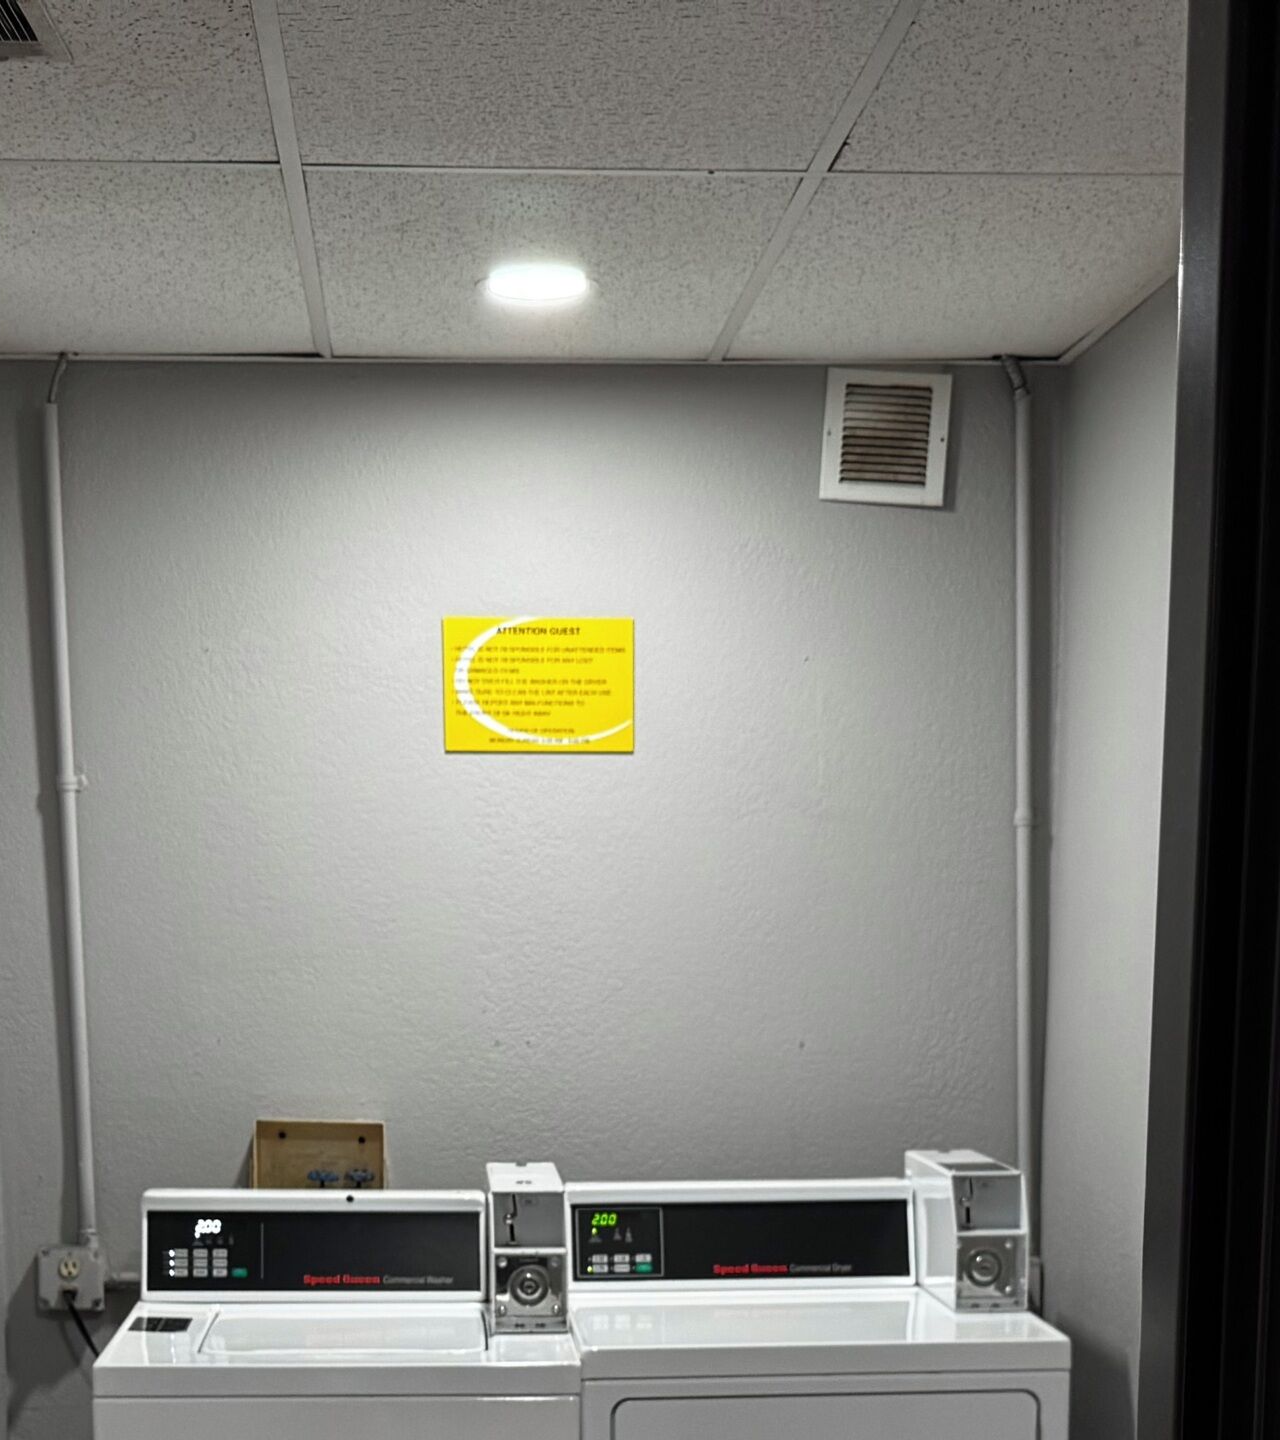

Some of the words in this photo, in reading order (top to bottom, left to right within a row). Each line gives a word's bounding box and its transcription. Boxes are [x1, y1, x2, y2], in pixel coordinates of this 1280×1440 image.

[496, 627, 547, 636] ATTENTION
[549, 627, 580, 636] GUEST
[713, 1264, 749, 1276] Speed
[750, 1263, 788, 1275] Queen
[303, 1274, 340, 1286] Speed
[342, 1274, 380, 1285] Queen
